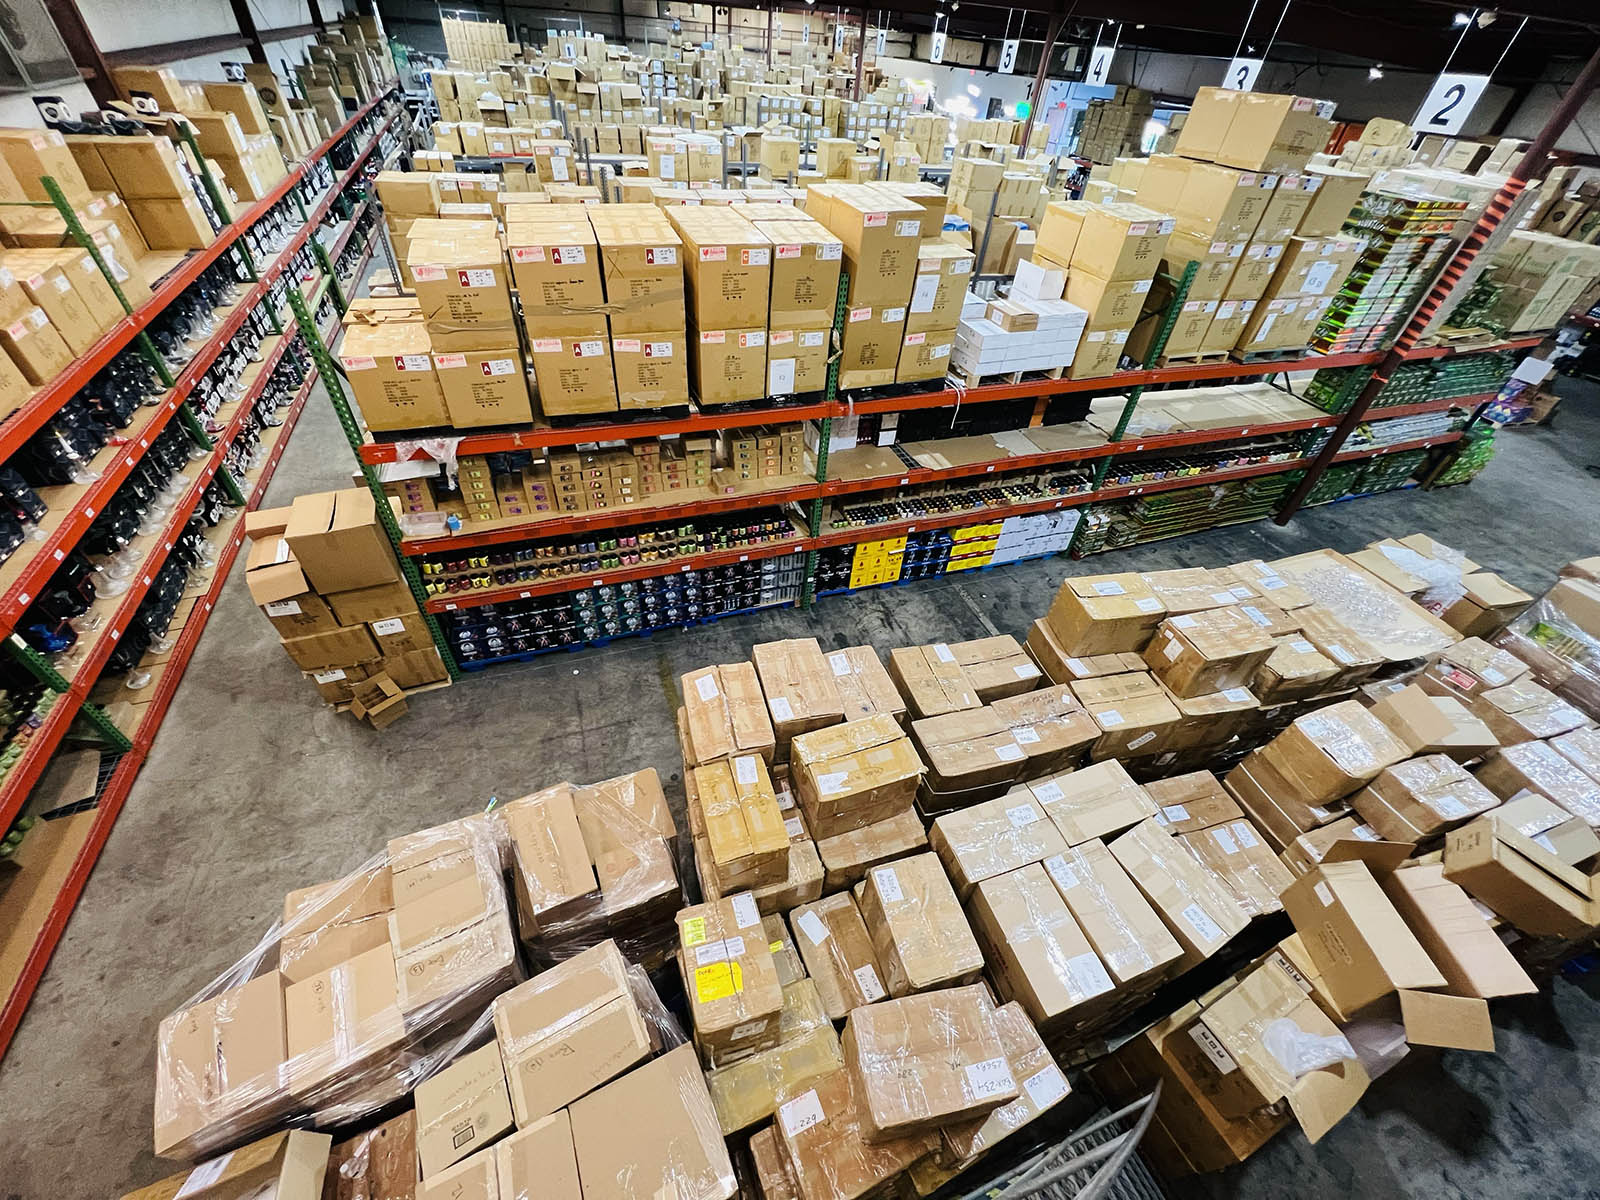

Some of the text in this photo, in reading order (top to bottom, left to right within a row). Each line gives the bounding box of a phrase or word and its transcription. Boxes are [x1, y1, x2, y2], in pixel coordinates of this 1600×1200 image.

[878, 34, 884, 50] 7
[934, 40, 941, 59] 6
[1003, 47, 1013, 69] 5
[1093, 56, 1103, 82] 4
[1237, 66, 1250, 90] 3
[1430, 84, 1467, 125] 2
[800, 1114, 816, 1127] 229
